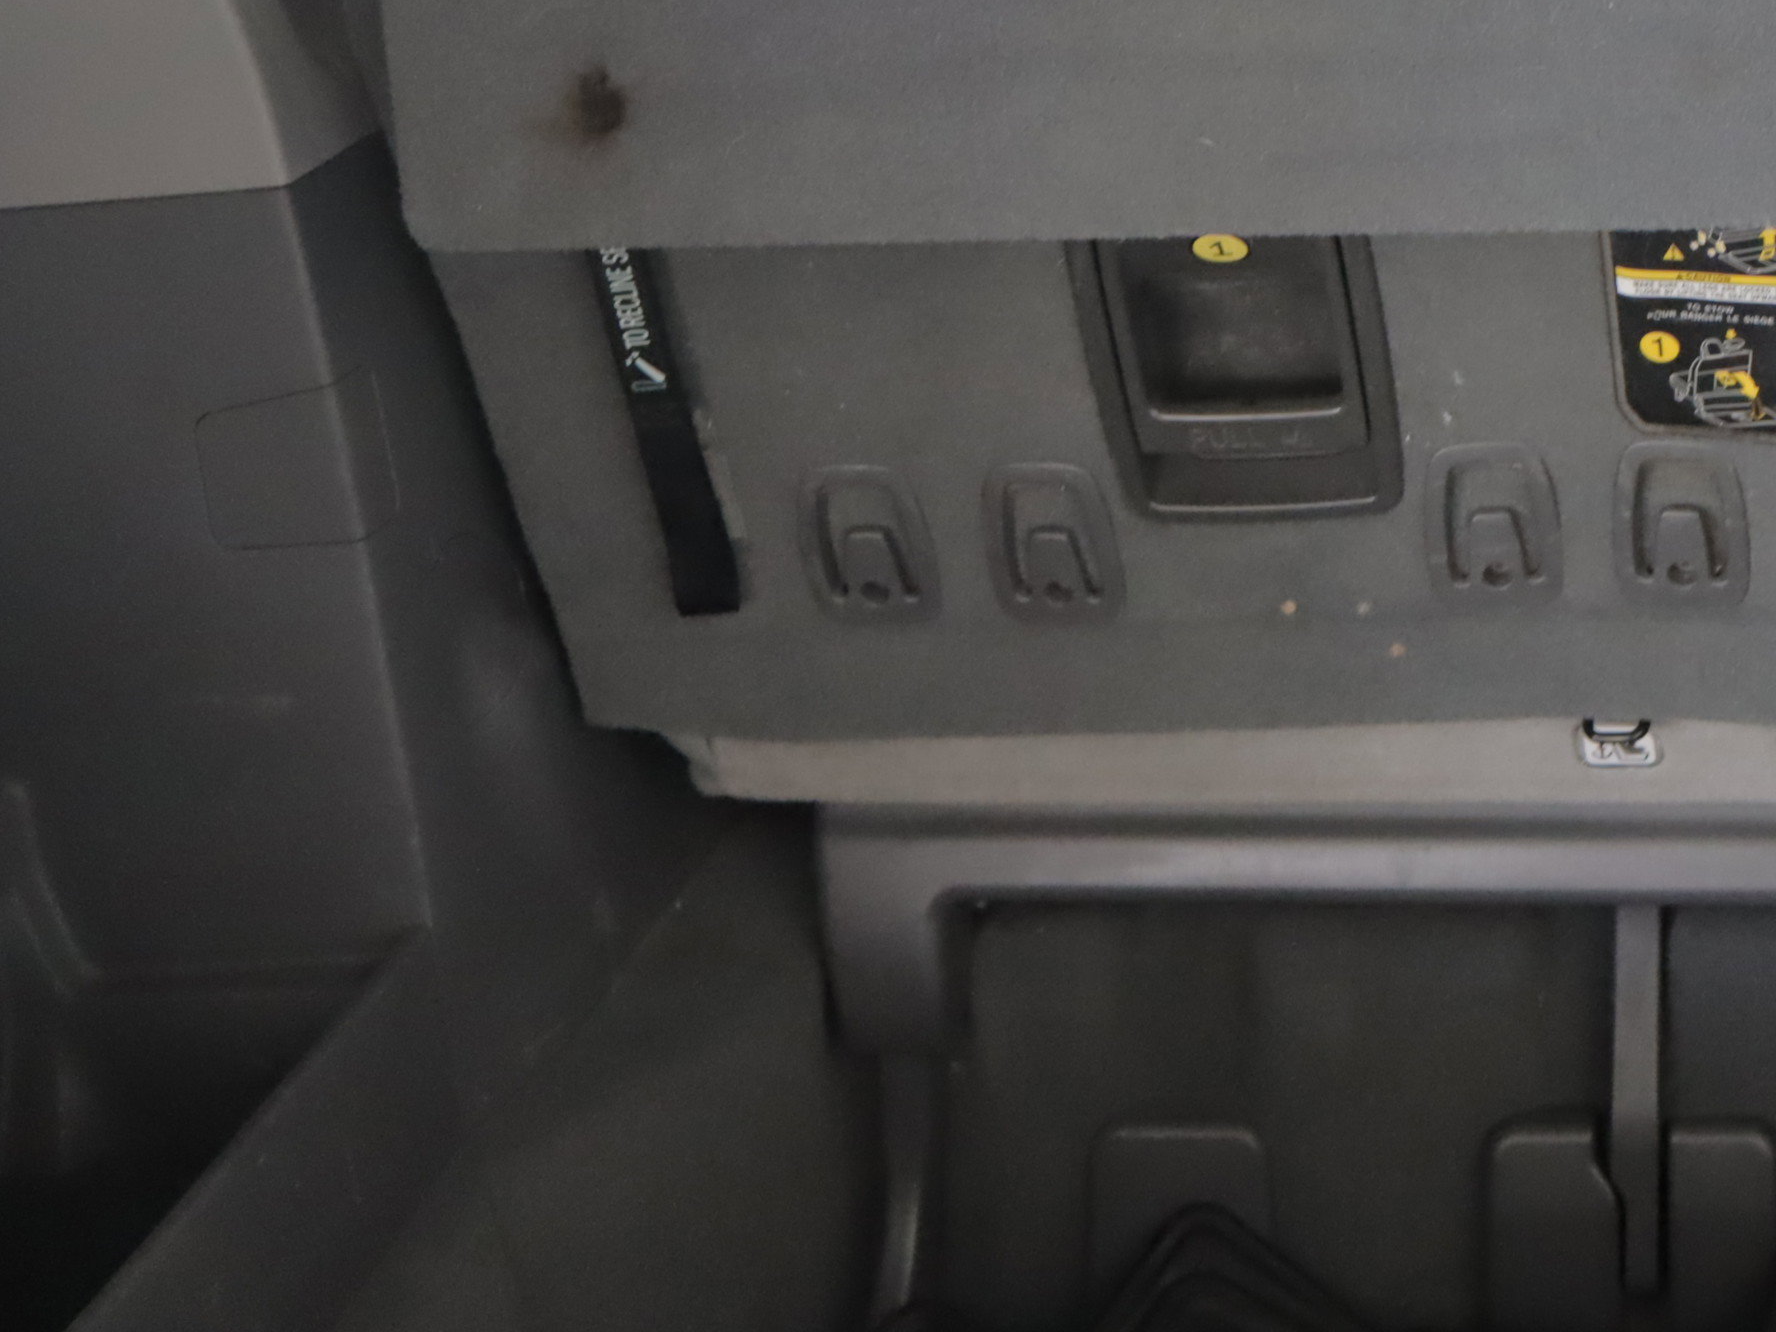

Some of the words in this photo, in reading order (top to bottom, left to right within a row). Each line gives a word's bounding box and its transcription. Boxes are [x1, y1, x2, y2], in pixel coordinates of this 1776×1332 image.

[1208, 240, 1234, 257] 1
[1686, 272, 1731, 284] CAUTION
[605, 265, 646, 329] RECLINE
[1647, 309, 1677, 321] POUR
[1680, 310, 1723, 323] RANGER
[1726, 314, 1740, 324] LE
[1687, 301, 1701, 312] TO
[1704, 303, 1735, 314] STOW
[622, 329, 651, 350] TO
[1651, 335, 1663, 358] 1
[1191, 427, 1266, 450] PULL
